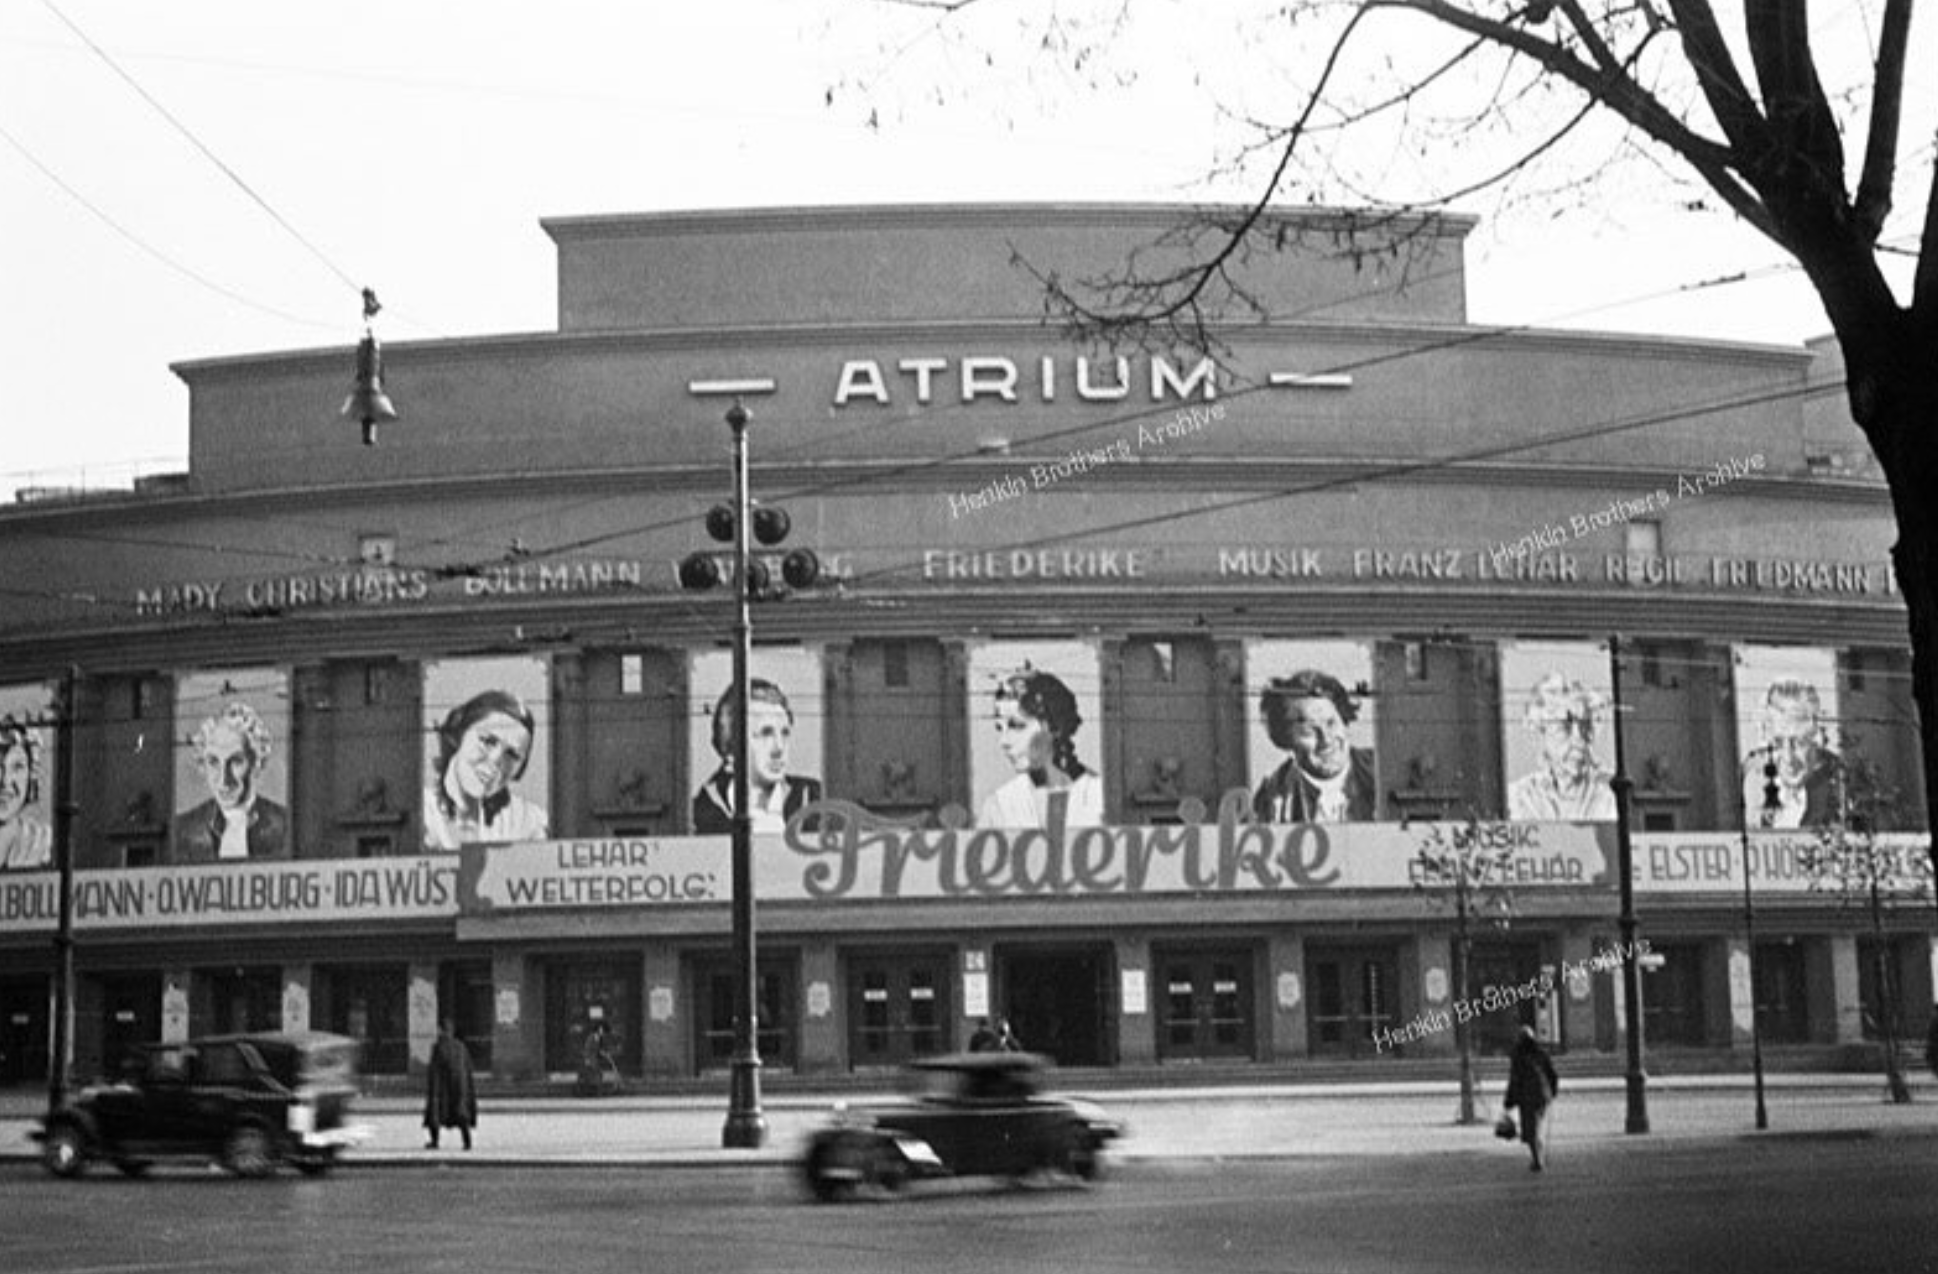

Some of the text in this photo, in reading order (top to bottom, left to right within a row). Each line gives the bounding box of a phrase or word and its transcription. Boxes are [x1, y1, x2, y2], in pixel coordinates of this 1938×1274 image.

[834, 355, 1217, 404] ATRIUM
[922, 549, 1146, 578] FRIEDERIKE
[1218, 548, 1322, 577] MUSIK
[1353, 548, 1463, 578] FRANZ
[1477, 551, 1578, 581] LEHAR
[136, 581, 223, 616] MADY
[247, 569, 427, 608] CHRISTIANS
[465, 560, 641, 594] BOLLMANN
[783, 788, 1341, 898] Friederike
[1650, 845, 1732, 881] ELSTER
[158, 871, 320, 915] O.WALLBURG
[505, 871, 716, 904] WELTERFOLG:
